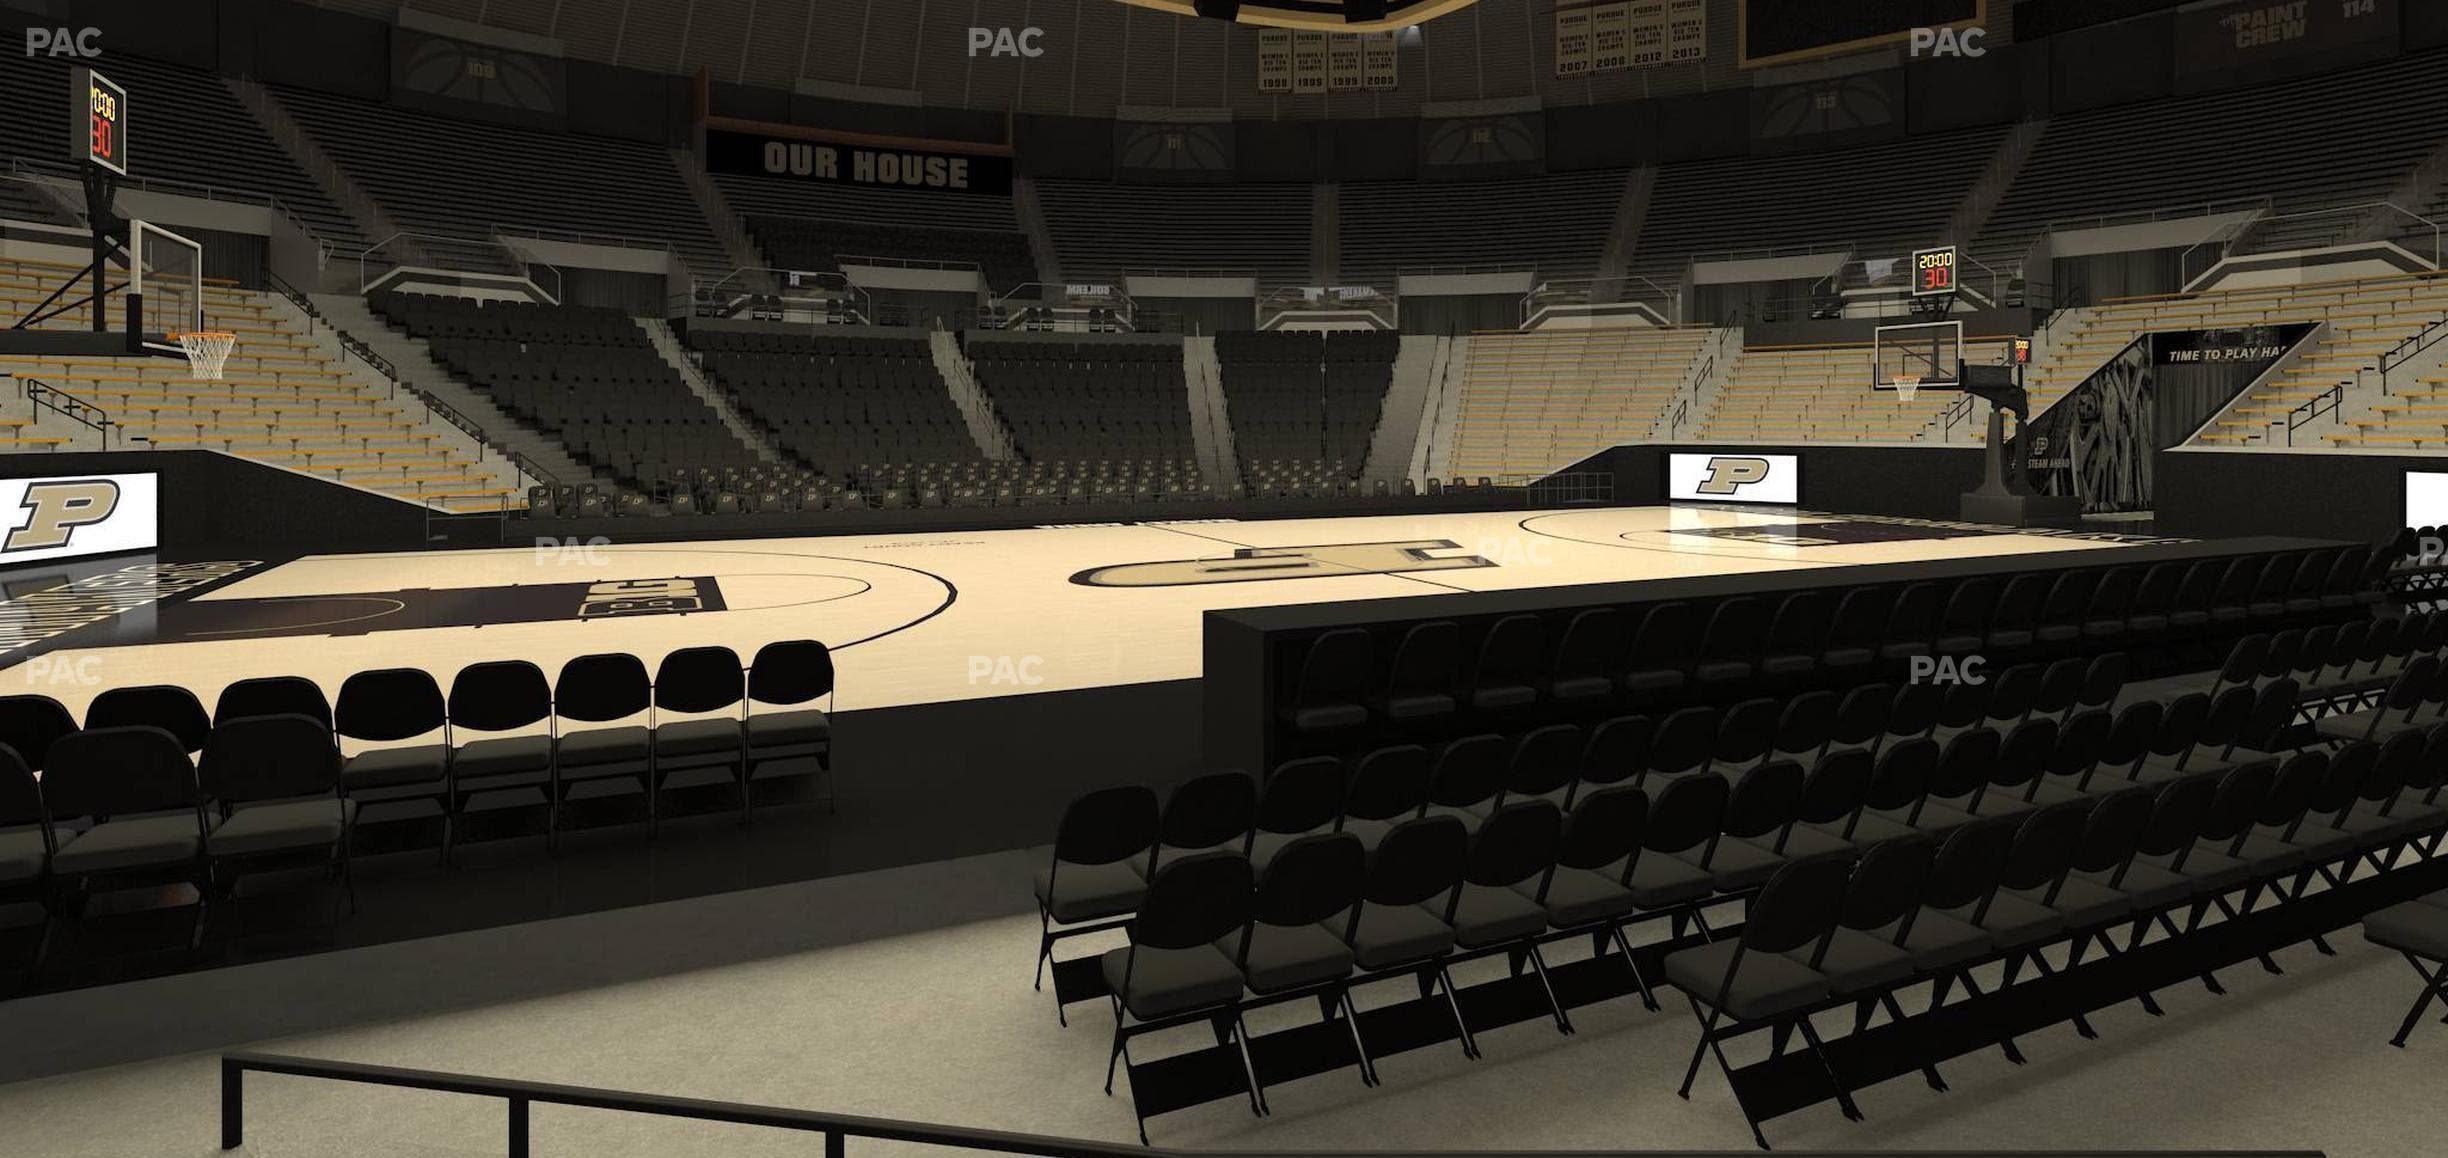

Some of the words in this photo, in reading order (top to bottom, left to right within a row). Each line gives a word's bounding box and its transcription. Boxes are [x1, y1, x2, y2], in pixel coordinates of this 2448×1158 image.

[2233, 2, 2307, 30] PAINT
[2236, 19, 2306, 48] CREW
[92, 114, 112, 159] 30
[764, 141, 838, 179] OUR
[853, 150, 969, 189] HOUSE
[1919, 252, 1952, 269] 20:00
[1924, 267, 1948, 290] 30
[2169, 349, 2200, 362] TIME
[2205, 349, 2220, 360] TO
[2225, 347, 2257, 360] PLAY
[1696, 457, 1769, 494] P
[2, 479, 120, 552] P
